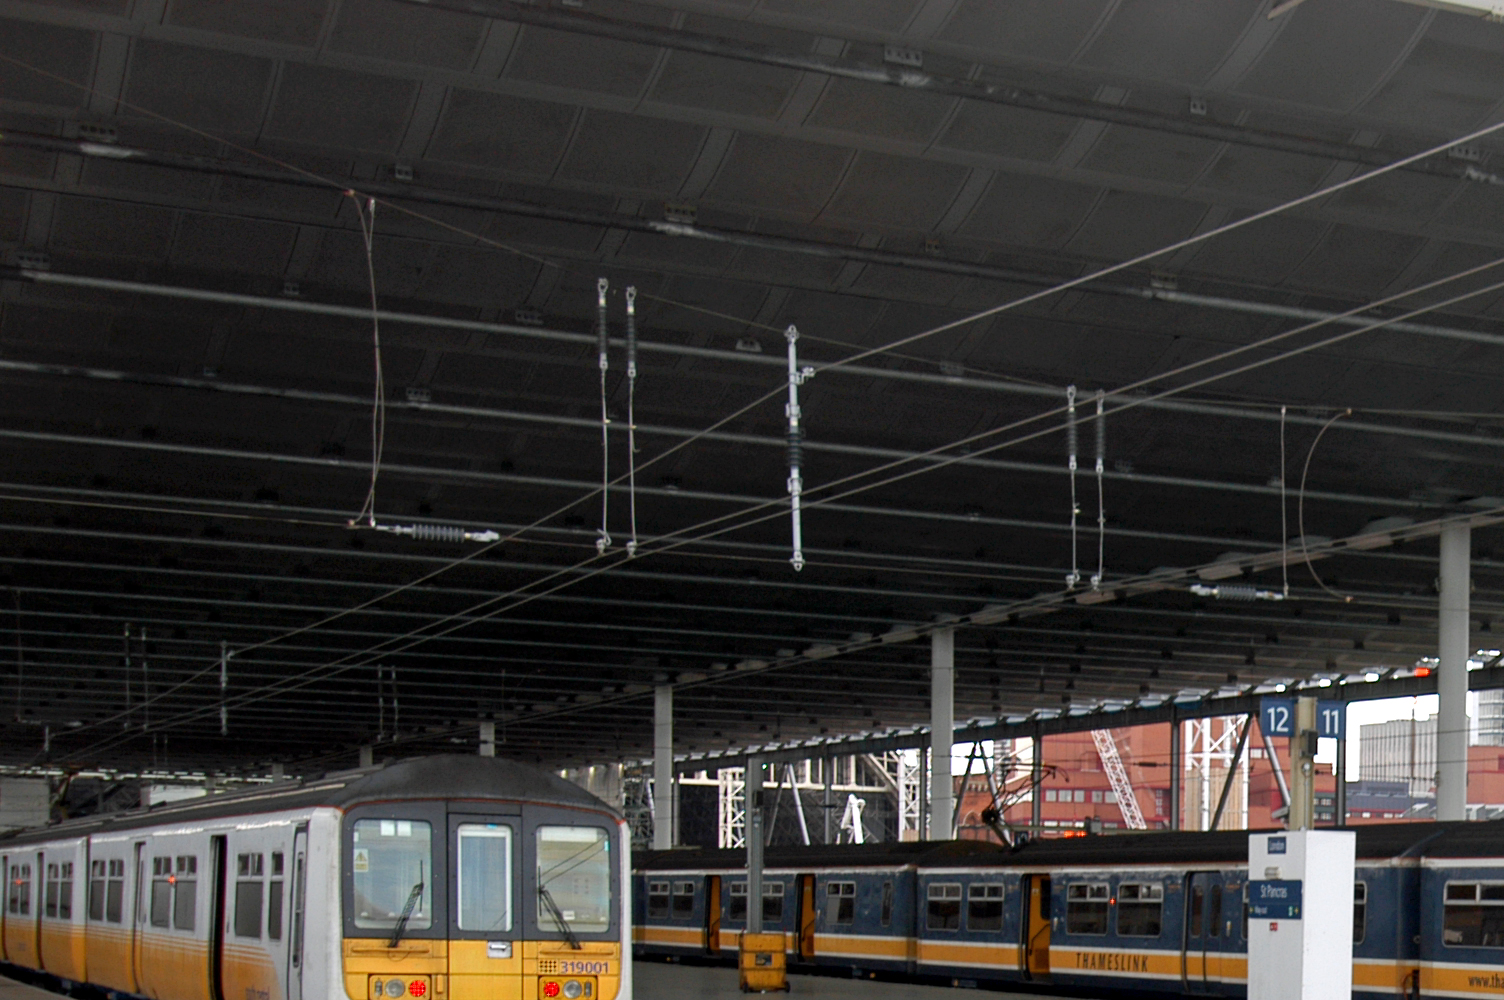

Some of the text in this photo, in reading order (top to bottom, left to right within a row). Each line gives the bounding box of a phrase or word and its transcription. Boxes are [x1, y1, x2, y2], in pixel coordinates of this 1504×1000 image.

[1267, 706, 1289, 732] 12
[1322, 708, 1339, 734] 11
[560, 961, 609, 974] 319001
[1076, 952, 1148, 972] THAMESLINK
